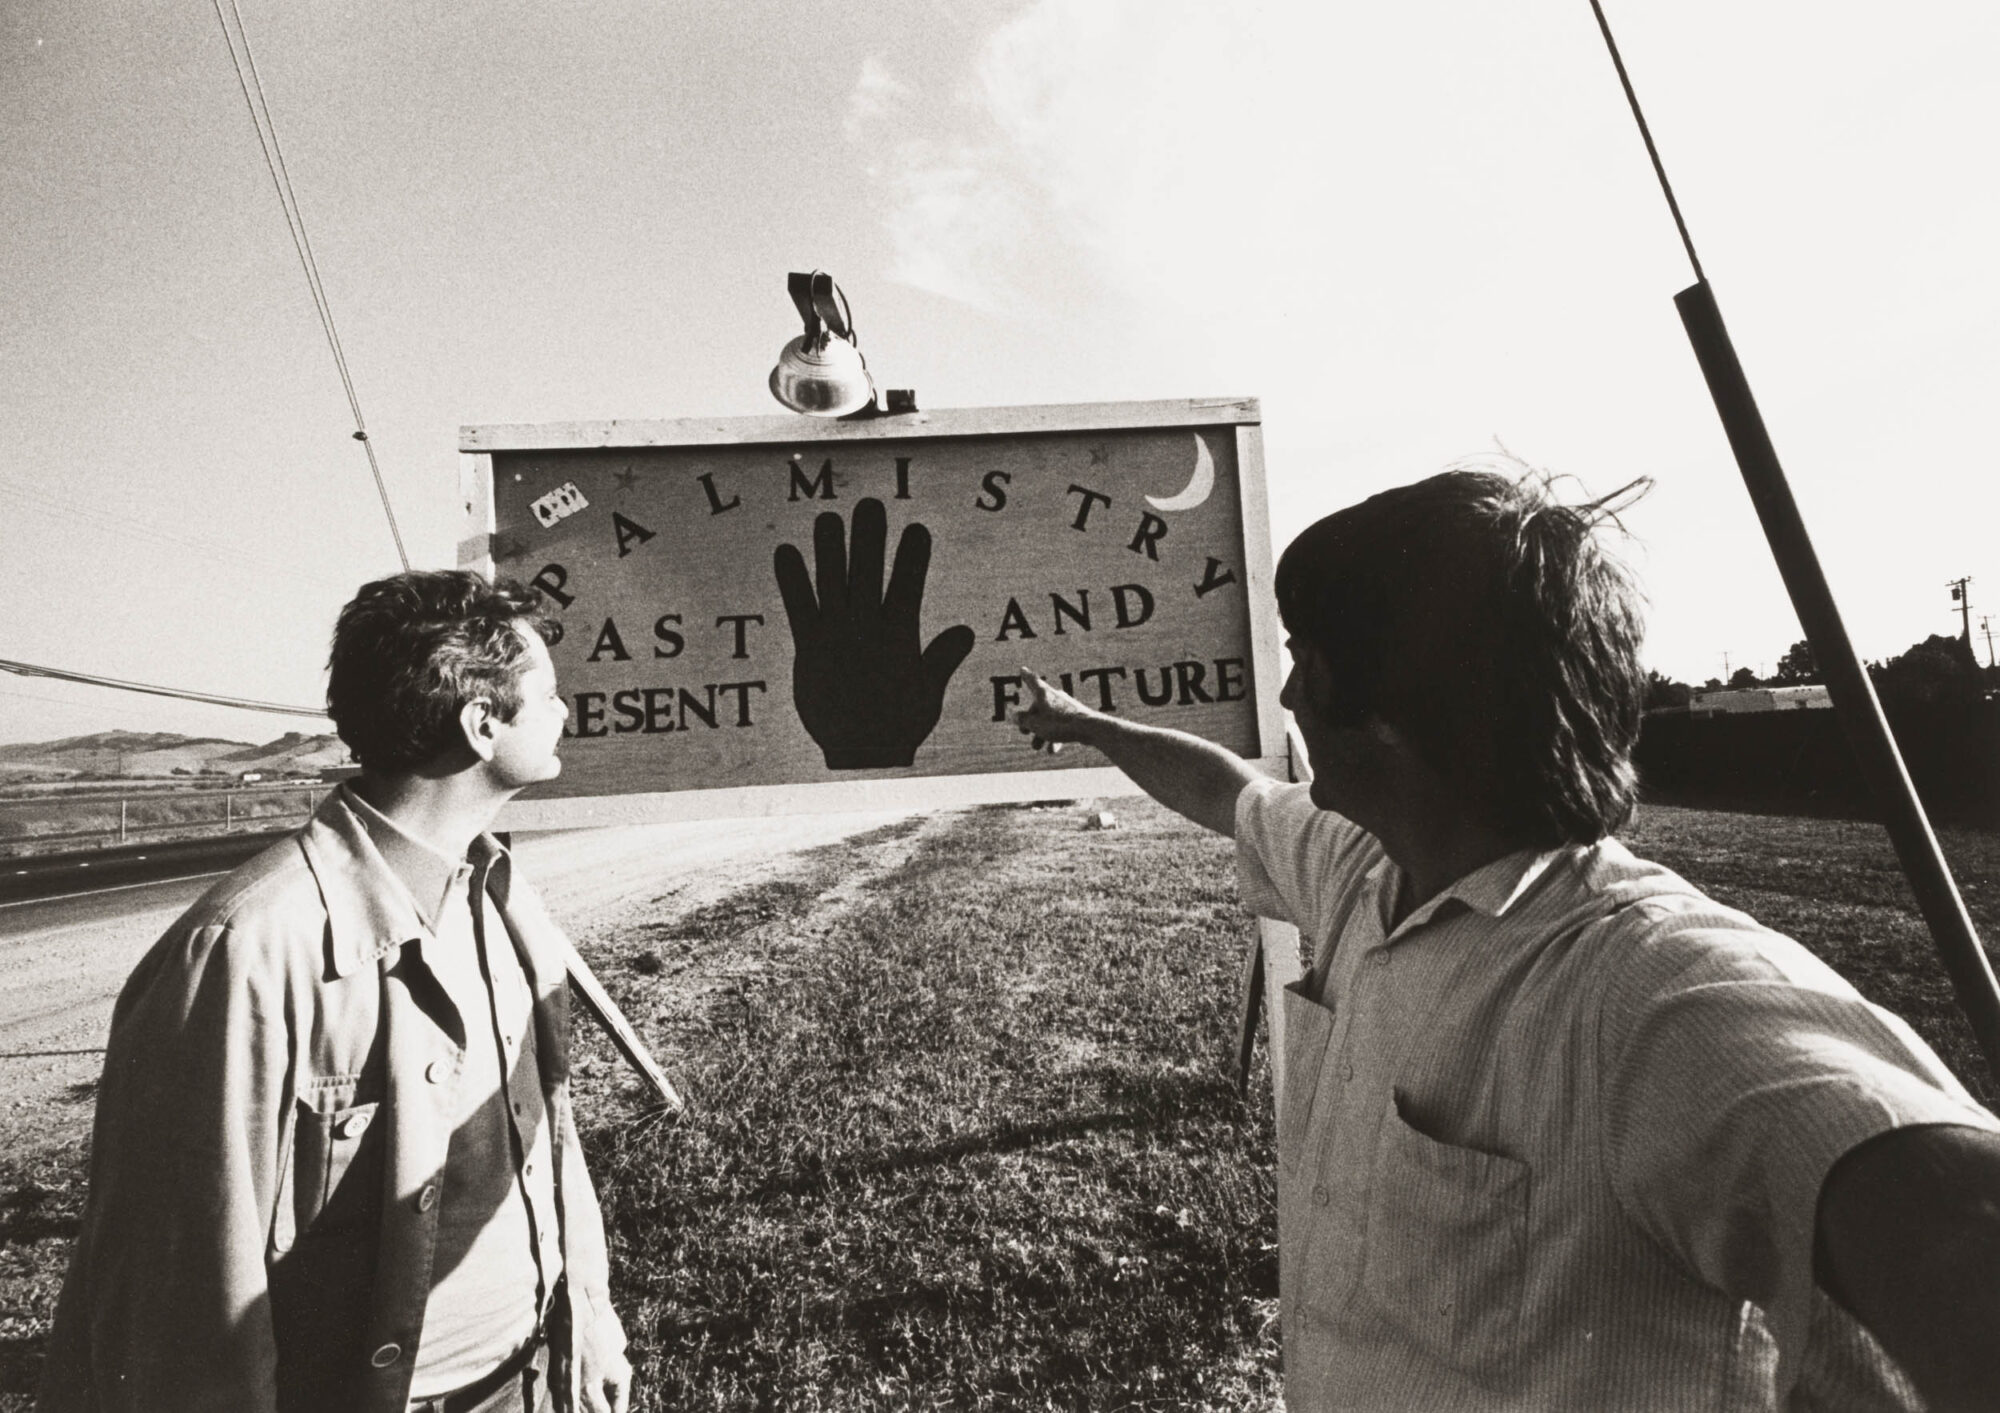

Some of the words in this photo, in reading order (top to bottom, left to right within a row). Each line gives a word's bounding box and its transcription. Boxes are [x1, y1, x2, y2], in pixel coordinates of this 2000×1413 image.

[530, 457, 1237, 610] PALMISTRY
[995, 583, 1155, 641] AND
[561, 681, 767, 738] ESENT
